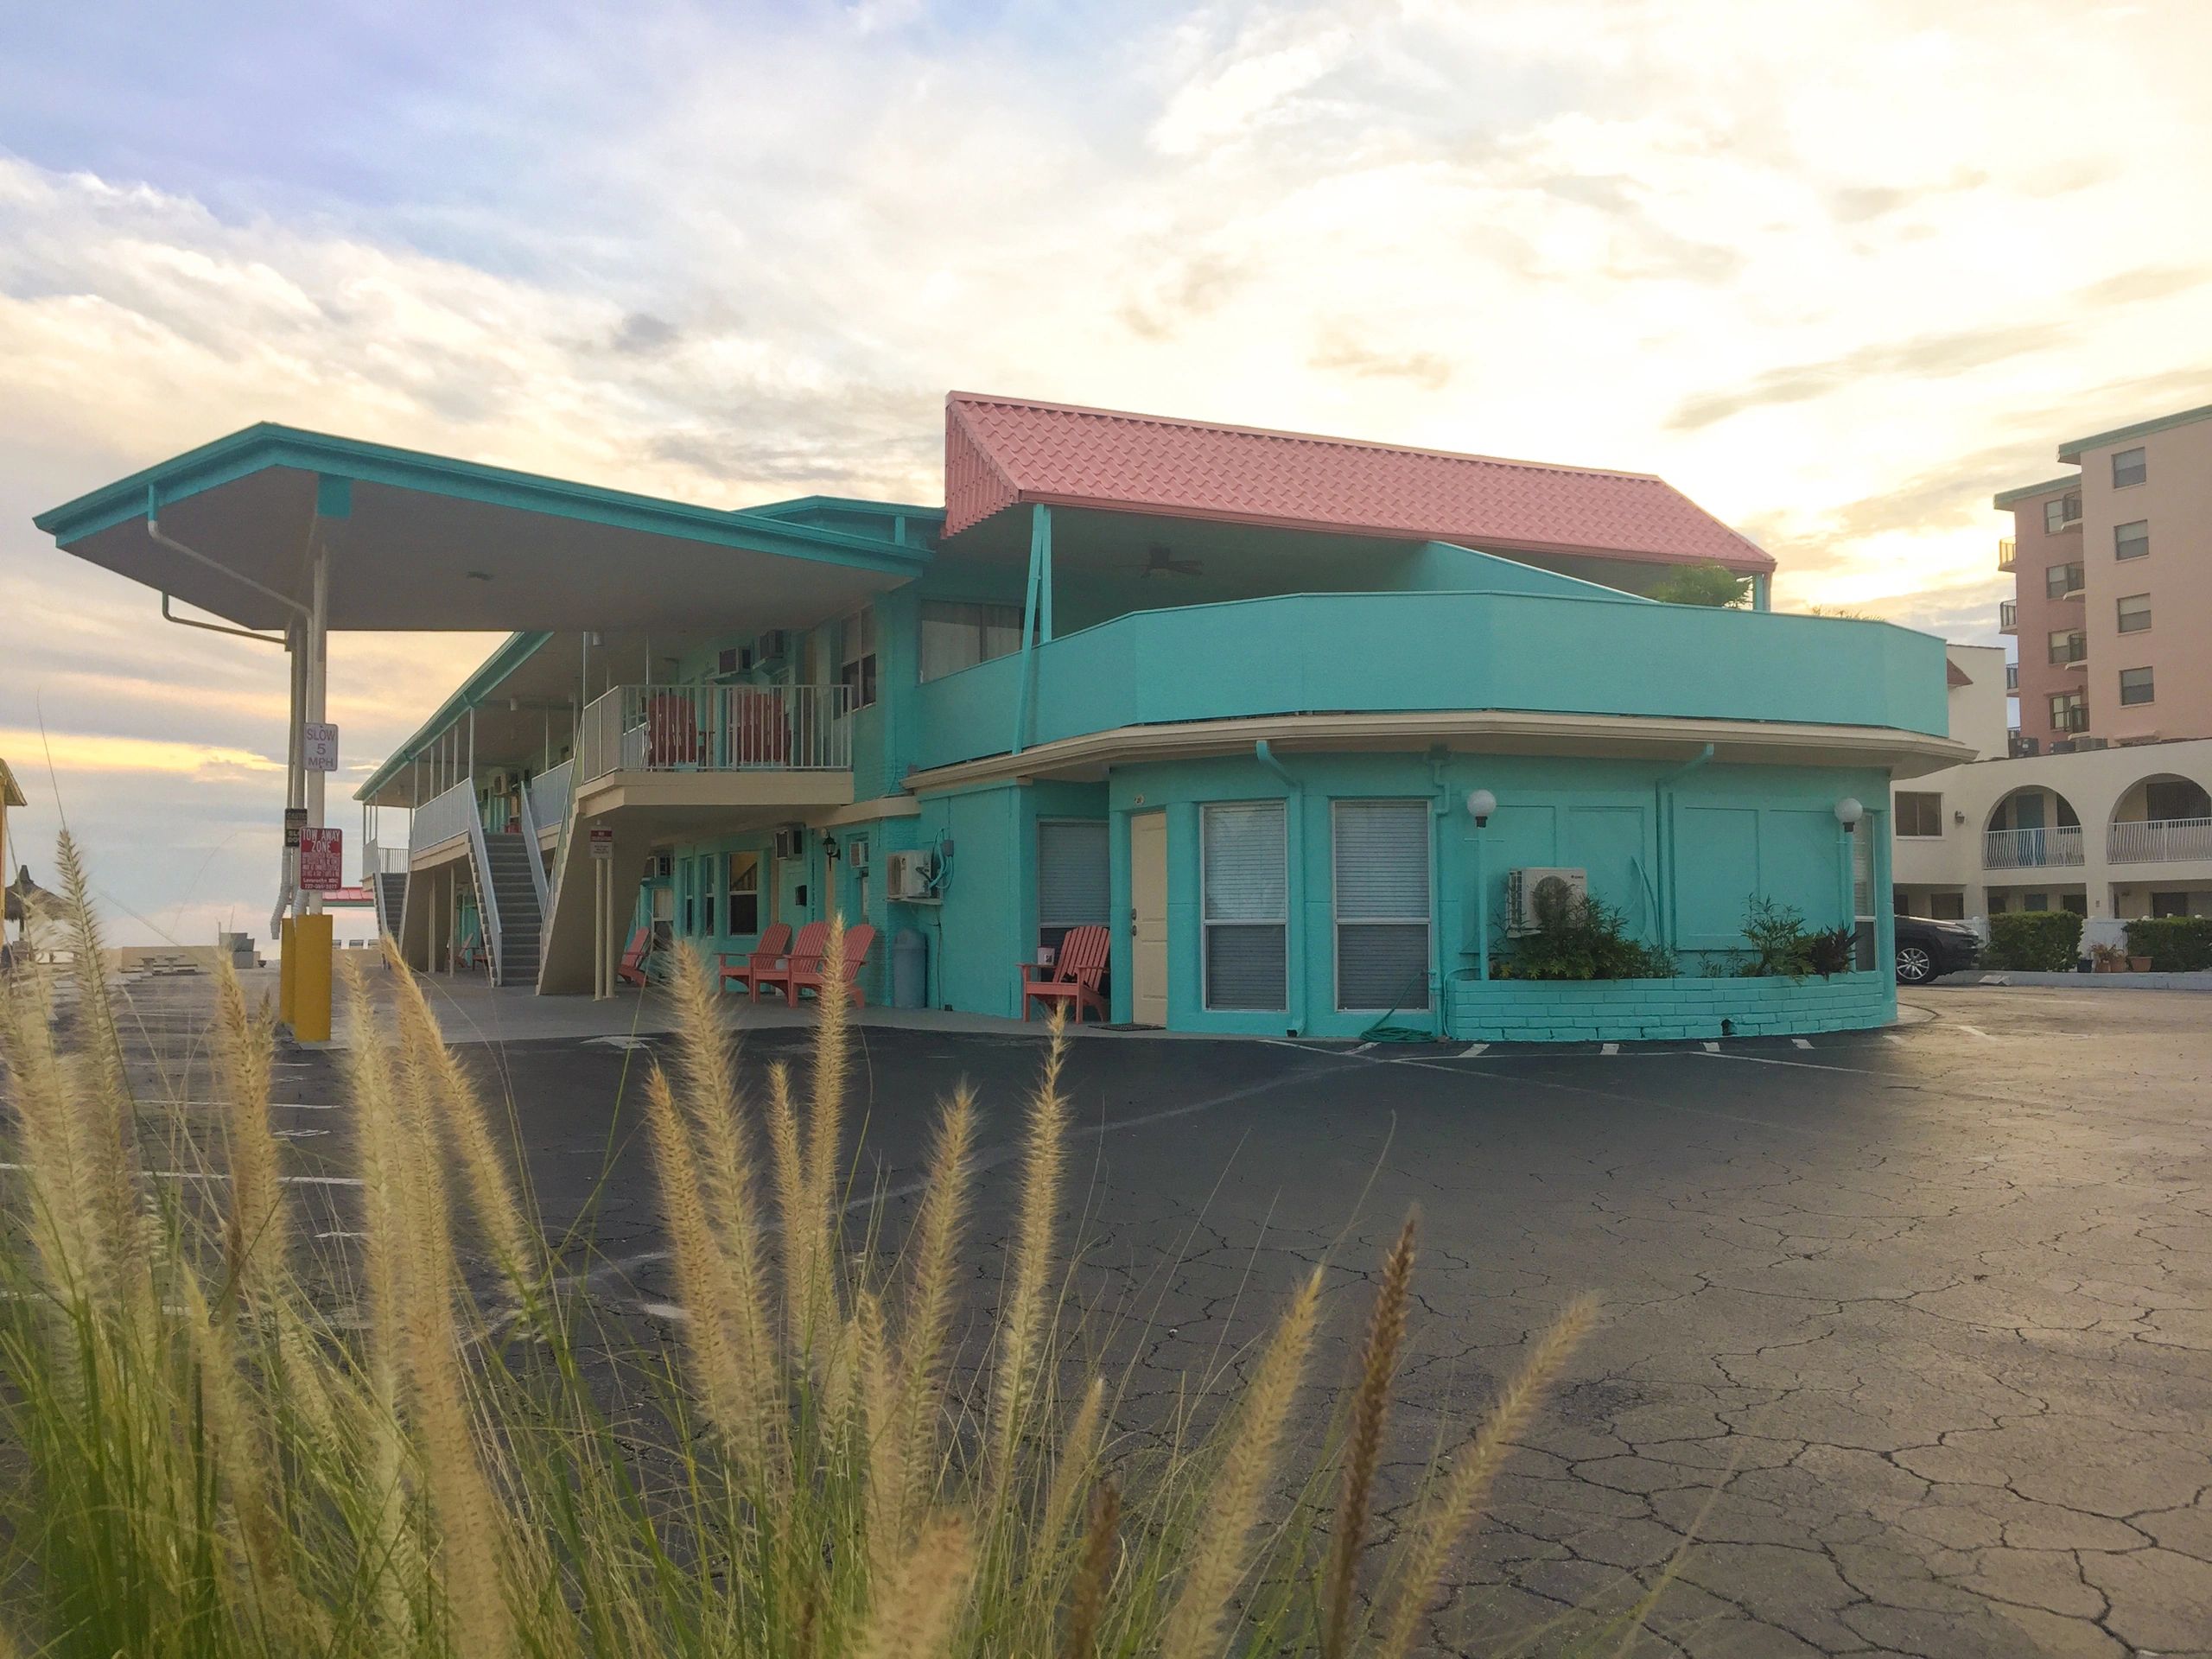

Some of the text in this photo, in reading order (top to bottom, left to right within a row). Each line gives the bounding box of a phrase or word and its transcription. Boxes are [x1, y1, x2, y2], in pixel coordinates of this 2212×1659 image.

[307, 728, 335, 741] SLOW
[316, 743, 326, 754] 5
[308, 757, 334, 766] MPH
[302, 829, 340, 842] TOW AWAY
[312, 841, 331, 853] ZONE
